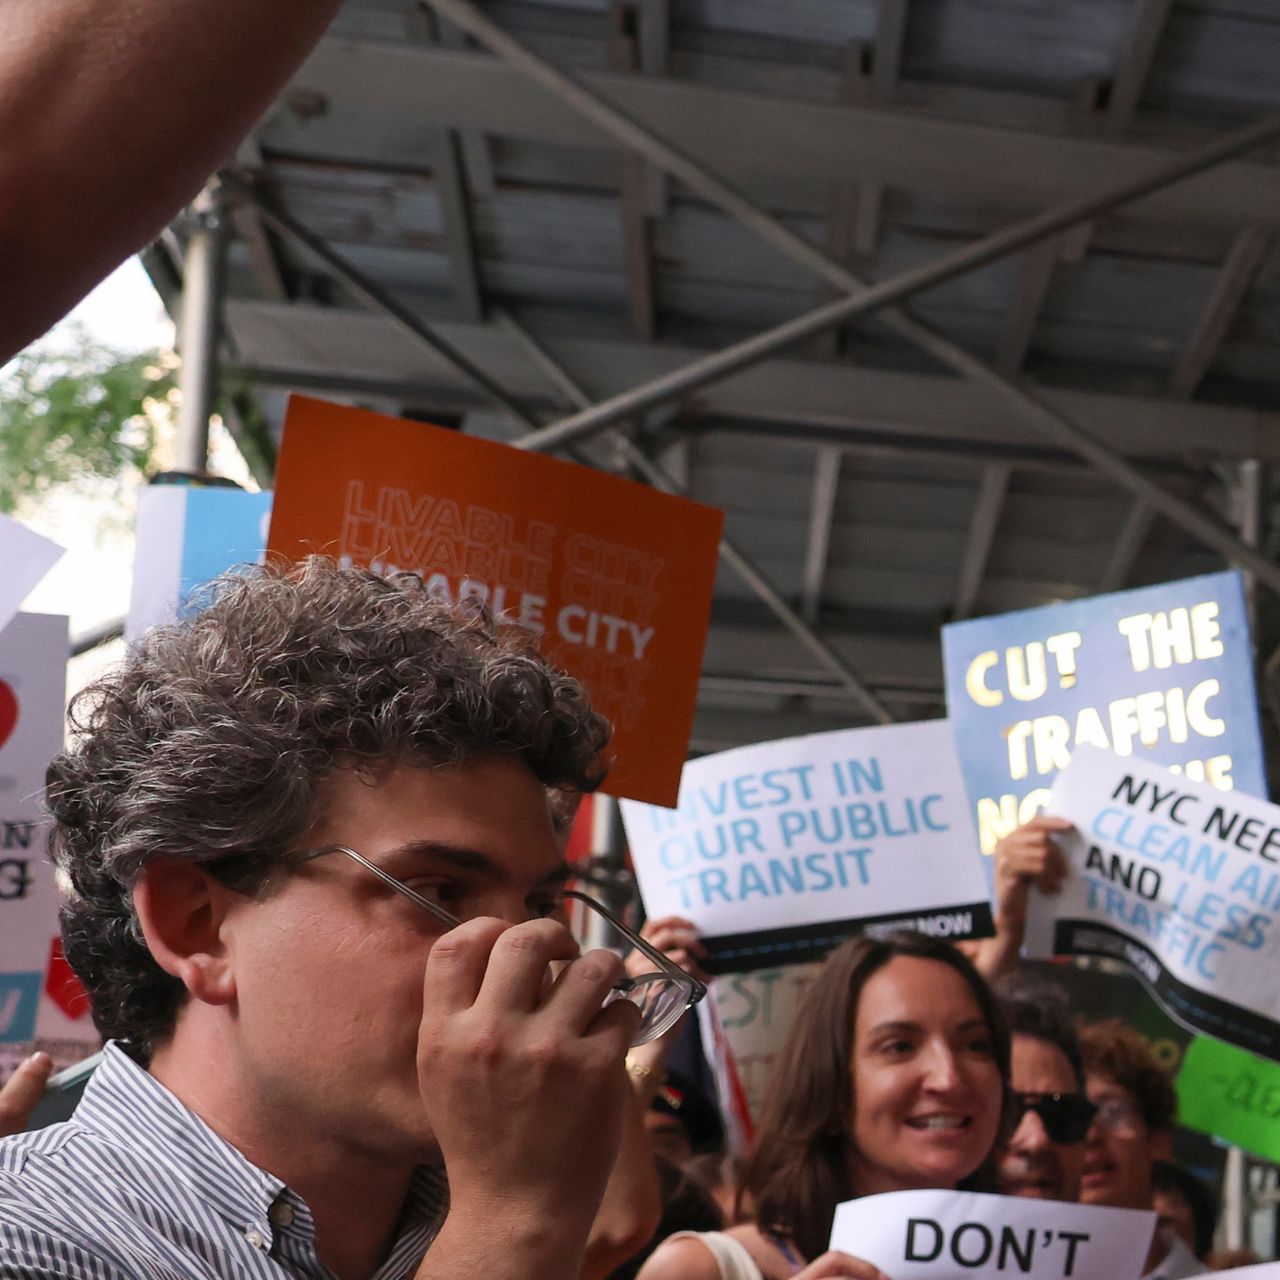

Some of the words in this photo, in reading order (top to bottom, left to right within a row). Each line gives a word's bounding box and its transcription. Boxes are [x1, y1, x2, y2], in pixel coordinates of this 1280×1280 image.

[346, 480, 557, 554] LIVABLE
[563, 533, 666, 592] CITY
[557, 604, 655, 660] CITY
[966, 631, 1081, 707] CUT
[1118, 600, 1224, 672] THE
[1004, 678, 1226, 780] TRAFFIC
[650, 764, 815, 834] INVEST
[832, 755, 885, 798] IN
[659, 817, 765, 870] OUR
[779, 794, 950, 848] PUBLIC
[1112, 775, 1199, 826] NYC
[668, 847, 874, 909] TRANSIT
[1091, 806, 1228, 884] CLEAN
[1083, 873, 1229, 980] TRAFFIC
[1085, 845, 1163, 902] AND
[1172, 881, 1274, 950] LESS
[904, 1217, 1090, 1277] DON'T
